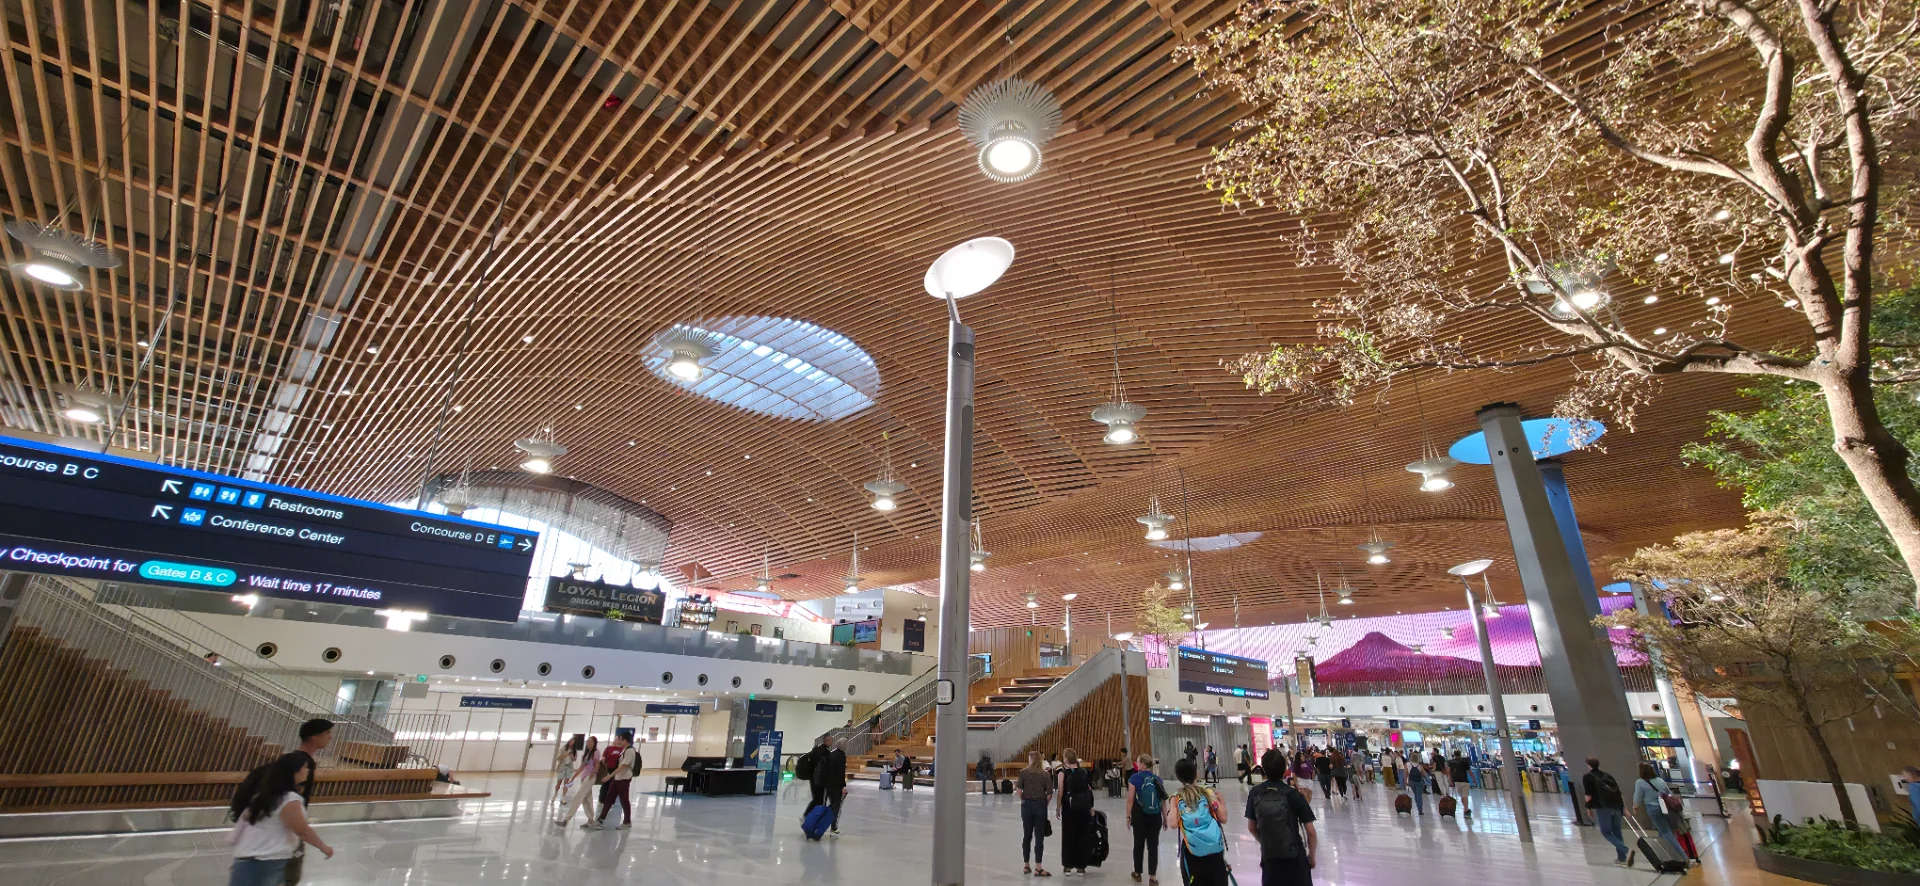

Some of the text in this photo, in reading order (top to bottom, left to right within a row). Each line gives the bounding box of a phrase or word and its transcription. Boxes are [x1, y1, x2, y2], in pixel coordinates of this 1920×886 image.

[63, 464, 79, 476] B
[84, 468, 99, 479] C
[269, 498, 343, 519] Restrooms
[210, 515, 344, 545] Conference Center
[410, 522, 495, 544] Concourse D E
[11, 548, 110, 571] Checkpoint
[113, 560, 136, 573] for
[148, 565, 187, 579] Gates
[190, 570, 201, 580] B
[203, 572, 213, 582] &
[216, 573, 228, 583] C
[250, 575, 279, 589] Wait
[282, 579, 311, 592] time
[315, 583, 332, 594] 17
[333, 586, 381, 600] minutes
[557, 582, 656, 605] LOYAL LEGION
[570, 597, 599, 606] OREGON
[602, 601, 619, 609] BEER
